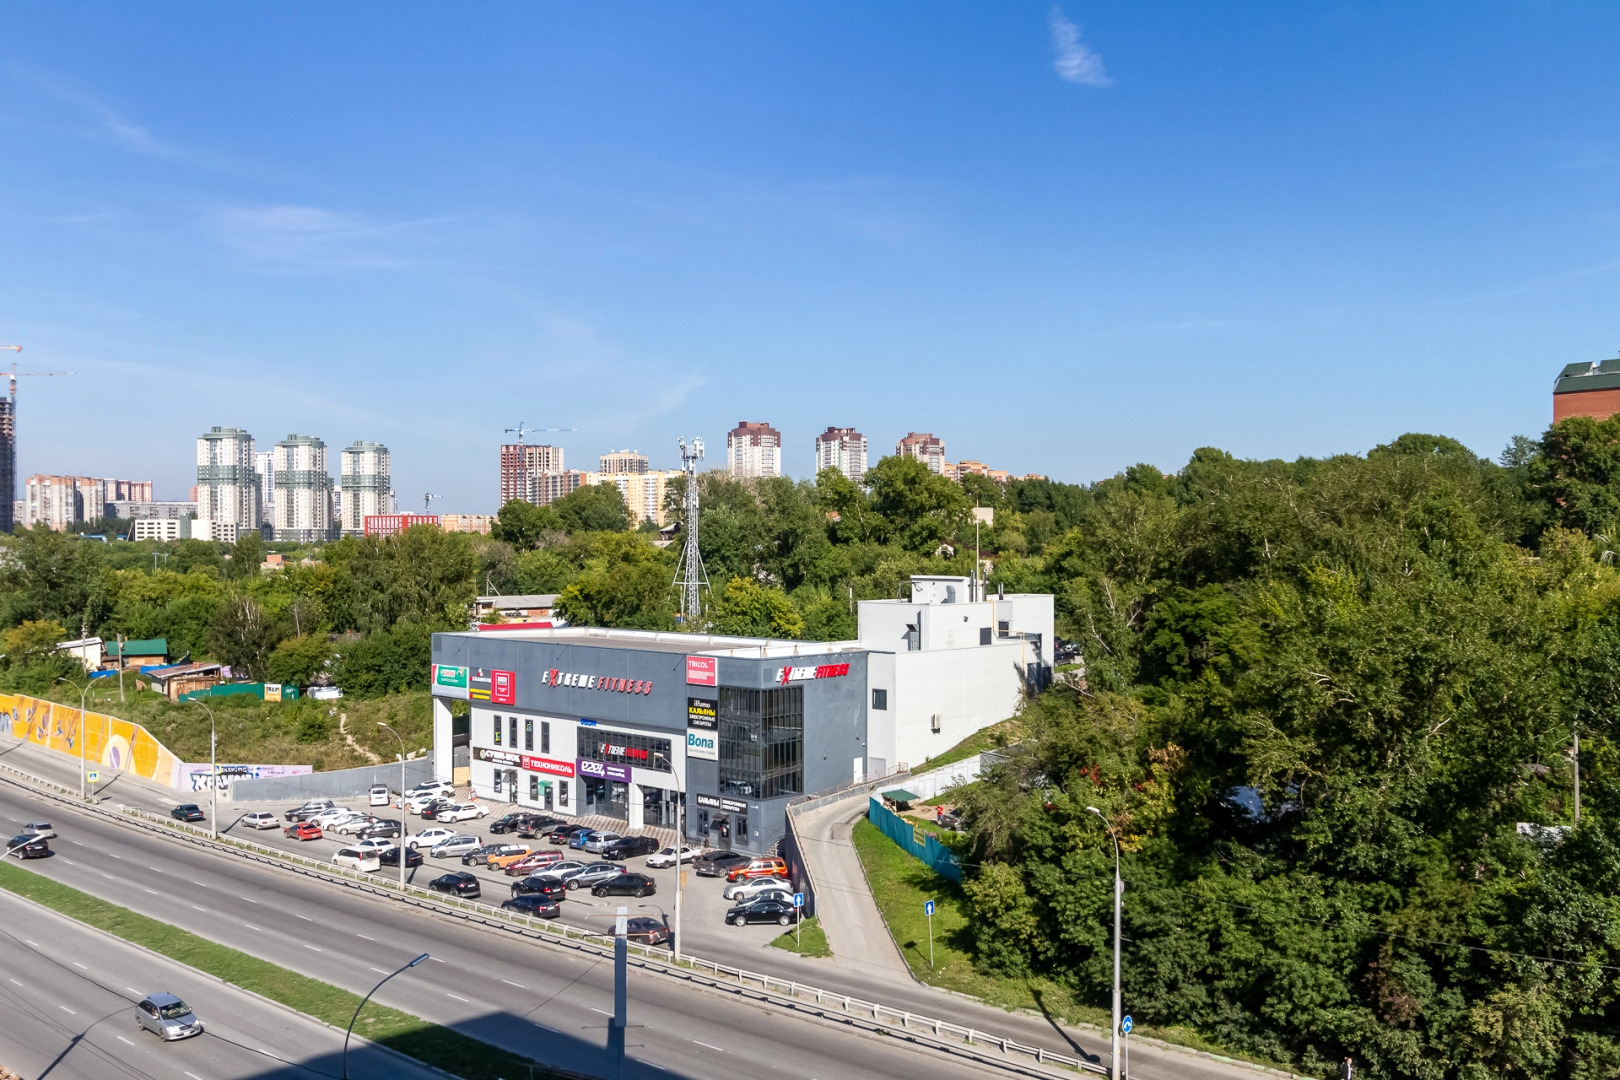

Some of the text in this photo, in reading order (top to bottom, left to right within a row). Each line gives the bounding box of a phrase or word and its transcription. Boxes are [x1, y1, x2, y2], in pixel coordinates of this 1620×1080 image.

[688, 660, 709, 669] TRICOL
[776, 662, 851, 686] EXTREME FITNESS
[541, 668, 653, 695] EXTREME FITNESS
[689, 706, 716, 717] КАЛЬЯНЫ
[688, 733, 714, 749] Bona
[530, 760, 573, 773] ТЕХНОНИКОЛЬ
